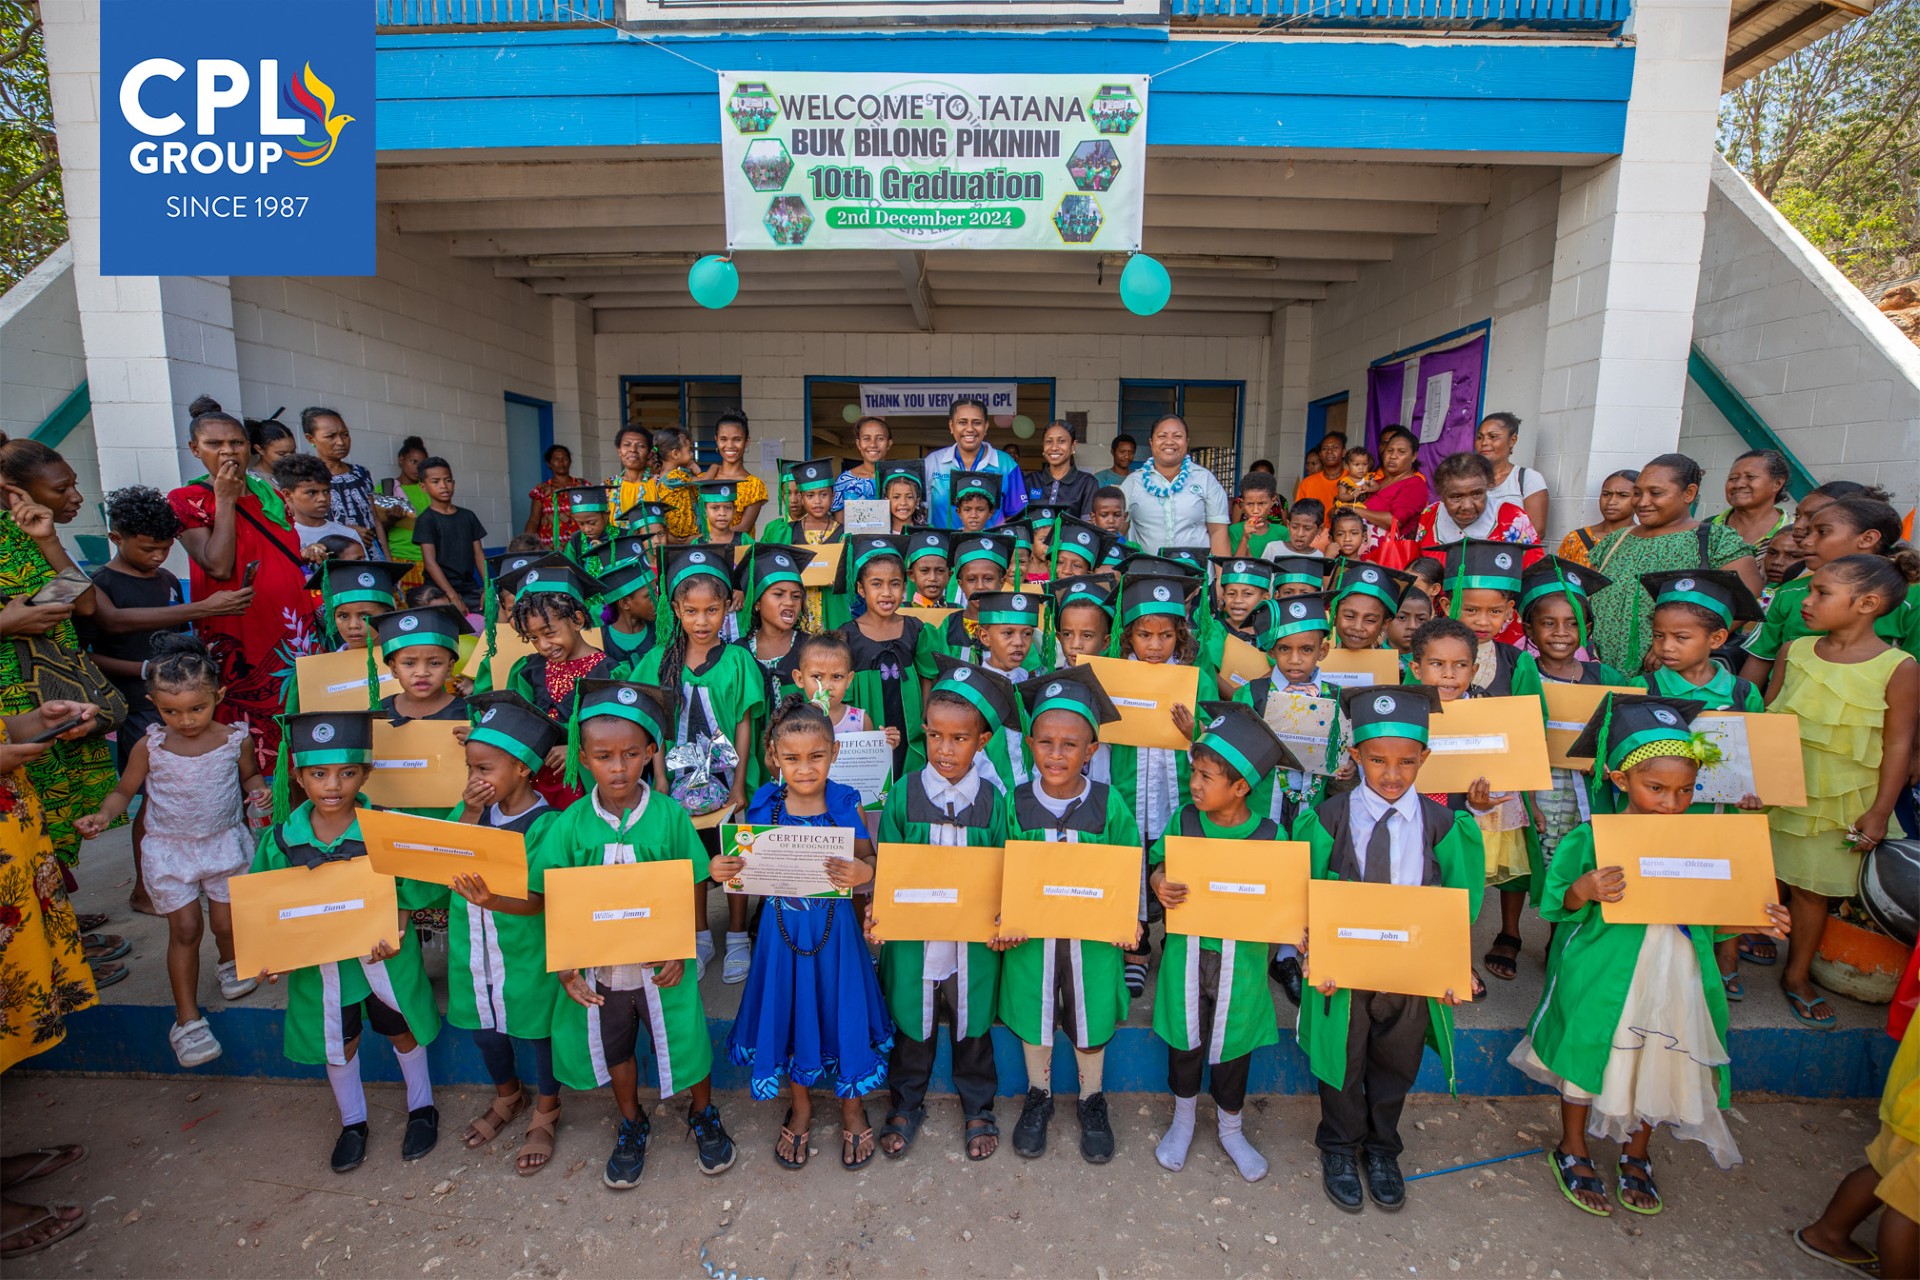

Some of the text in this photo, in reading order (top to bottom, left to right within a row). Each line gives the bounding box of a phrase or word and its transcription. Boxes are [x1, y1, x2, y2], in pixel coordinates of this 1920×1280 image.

[779, 94, 924, 120] WELCOME
[933, 94, 969, 121] TO
[978, 95, 1086, 122] TATANA
[791, 127, 1060, 158] BUK BILONG PIKININI
[809, 167, 1042, 200] 10th Graduation
[837, 210, 1013, 228] 2nd December 2024
[865, 394, 900, 408] THANK
[903, 394, 925, 408] YOU
[928, 394, 954, 408] VERY
[993, 393, 1012, 407] CPL
[840, 739, 884, 748] TIFICATE
[768, 833, 845, 844] CERTIFICATE
[622, 911, 646, 919] Jimmy
[1380, 932, 1399, 941] John
